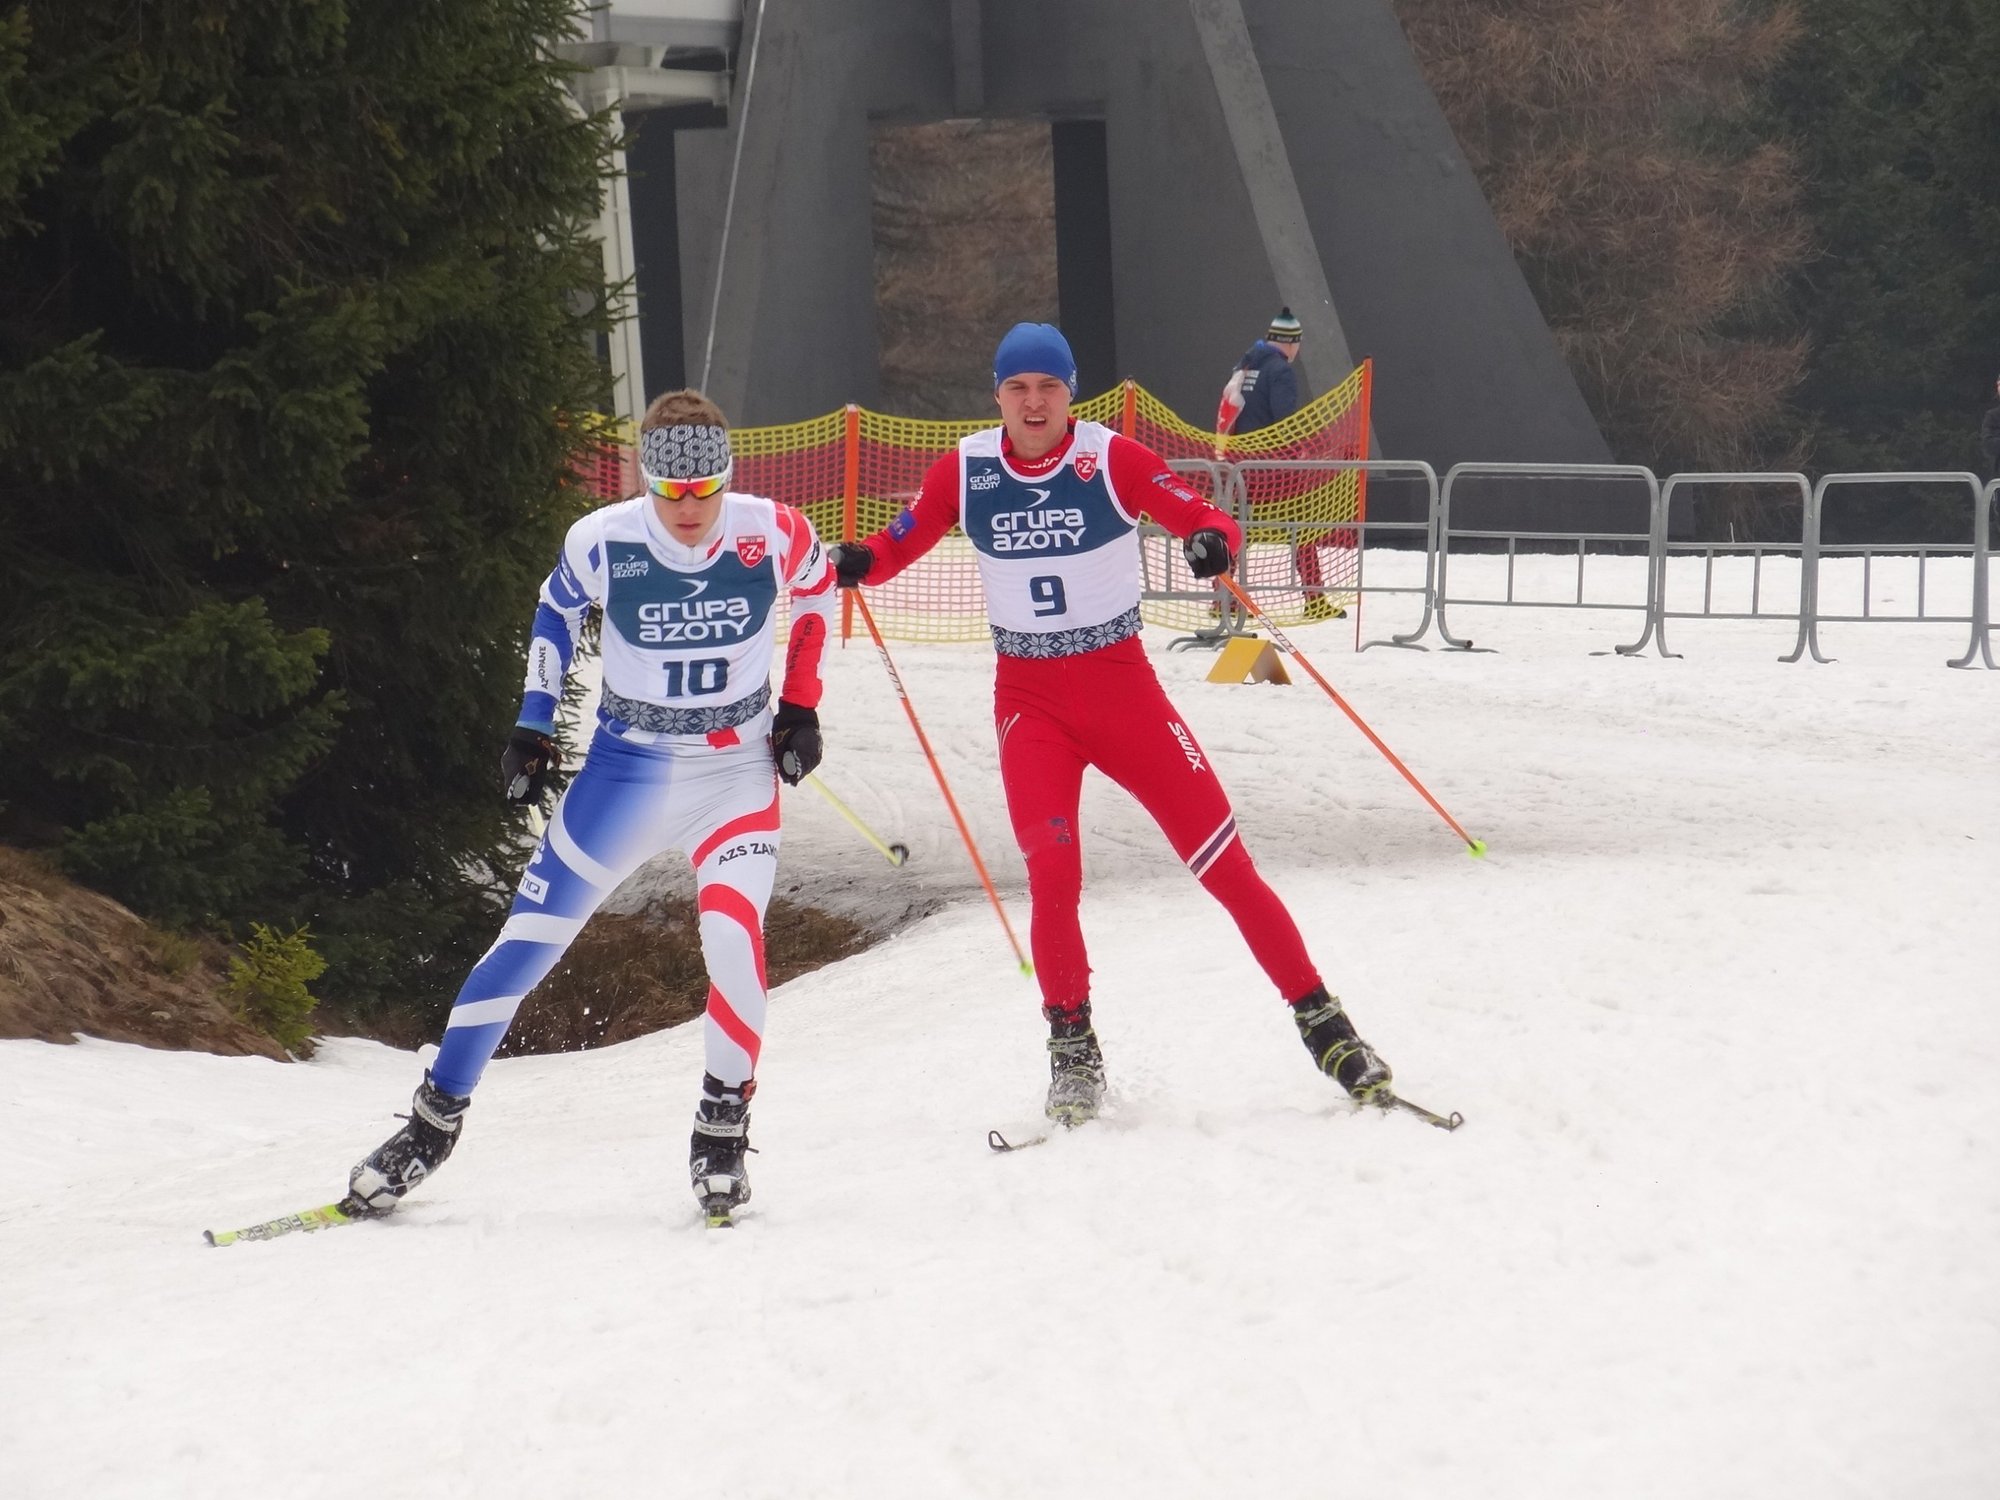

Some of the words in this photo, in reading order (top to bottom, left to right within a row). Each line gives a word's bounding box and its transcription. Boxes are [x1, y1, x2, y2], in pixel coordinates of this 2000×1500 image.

[1029, 575, 1067, 617] 9
[662, 657, 730, 697] 10
[718, 845, 748, 866] AZS
